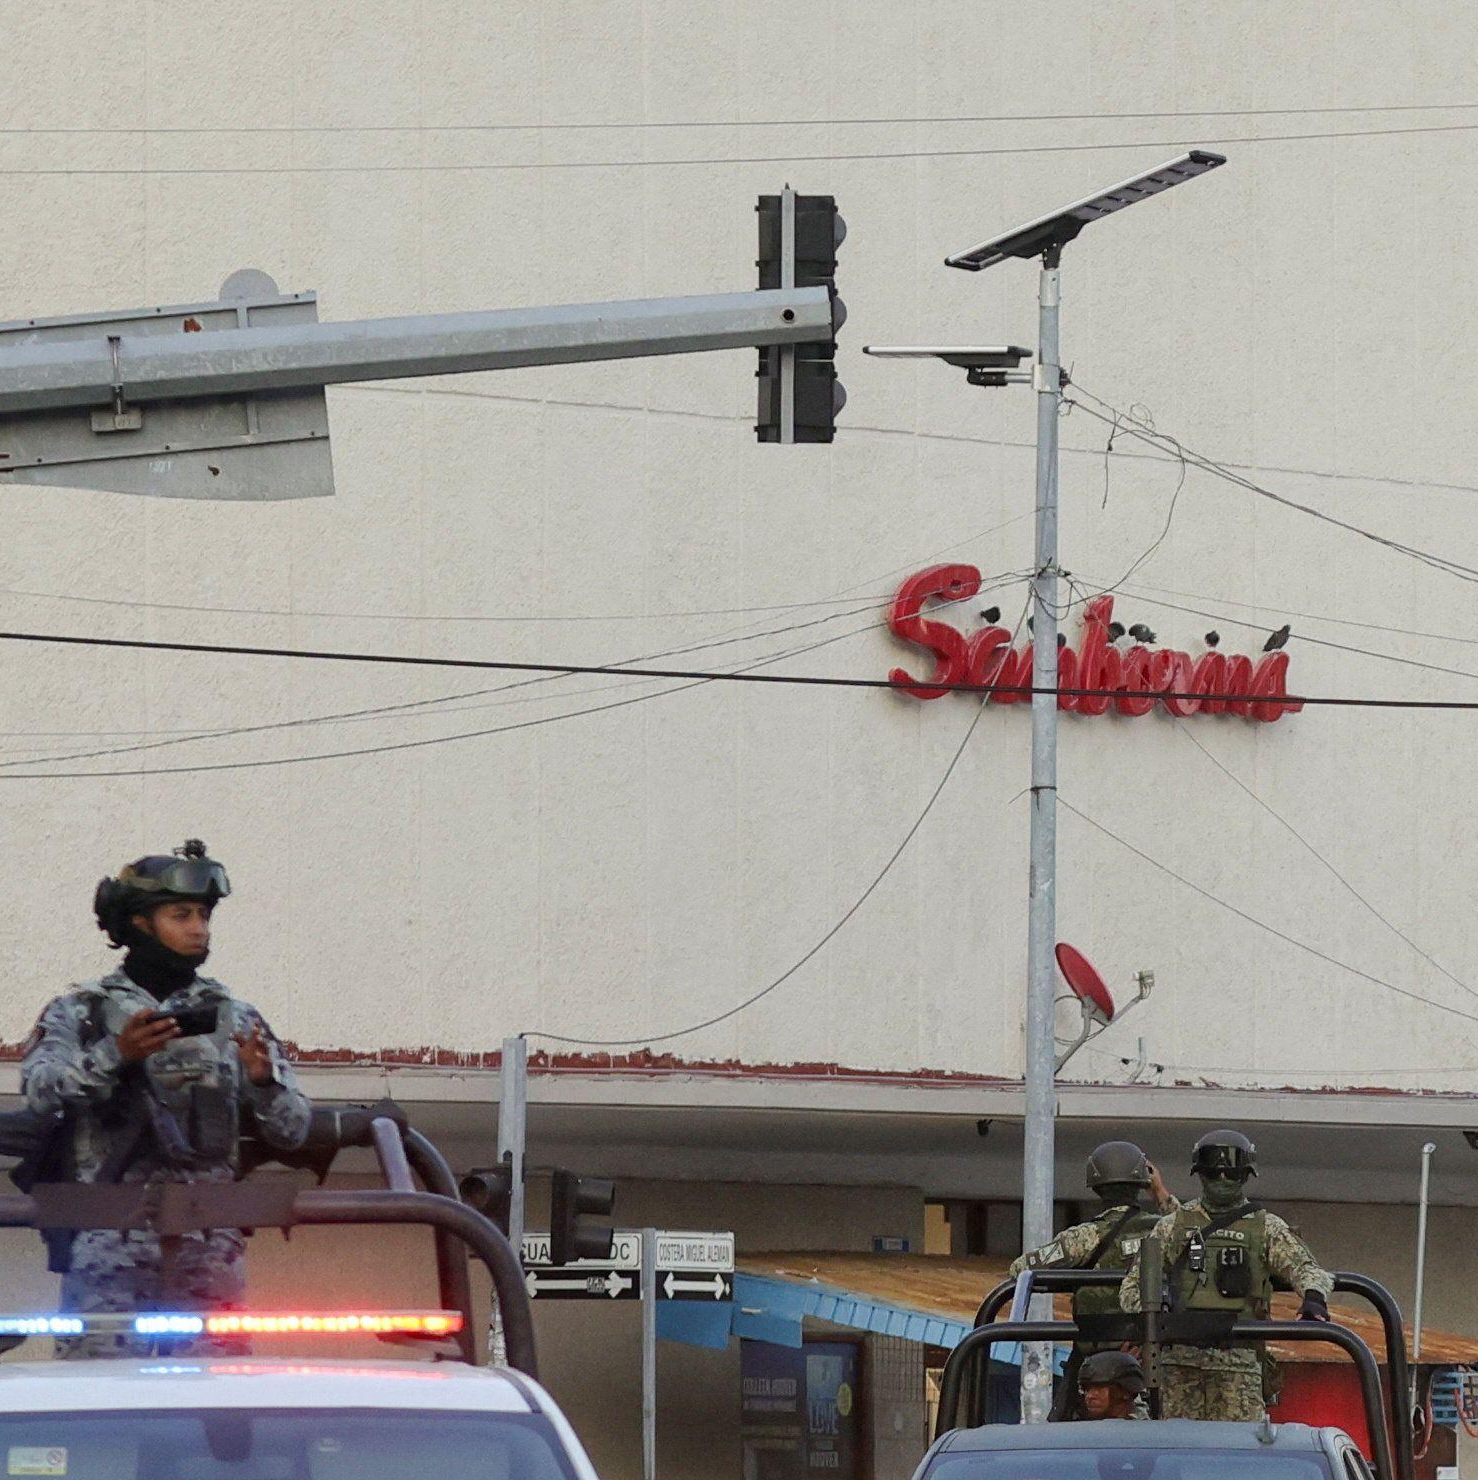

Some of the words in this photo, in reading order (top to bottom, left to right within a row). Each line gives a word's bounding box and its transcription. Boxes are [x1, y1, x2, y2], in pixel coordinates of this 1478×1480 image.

[659, 1242, 685, 1262] COSTERA
[685, 1243, 707, 1263] MIGUEL
[707, 1244, 731, 1263] ALEMAN
